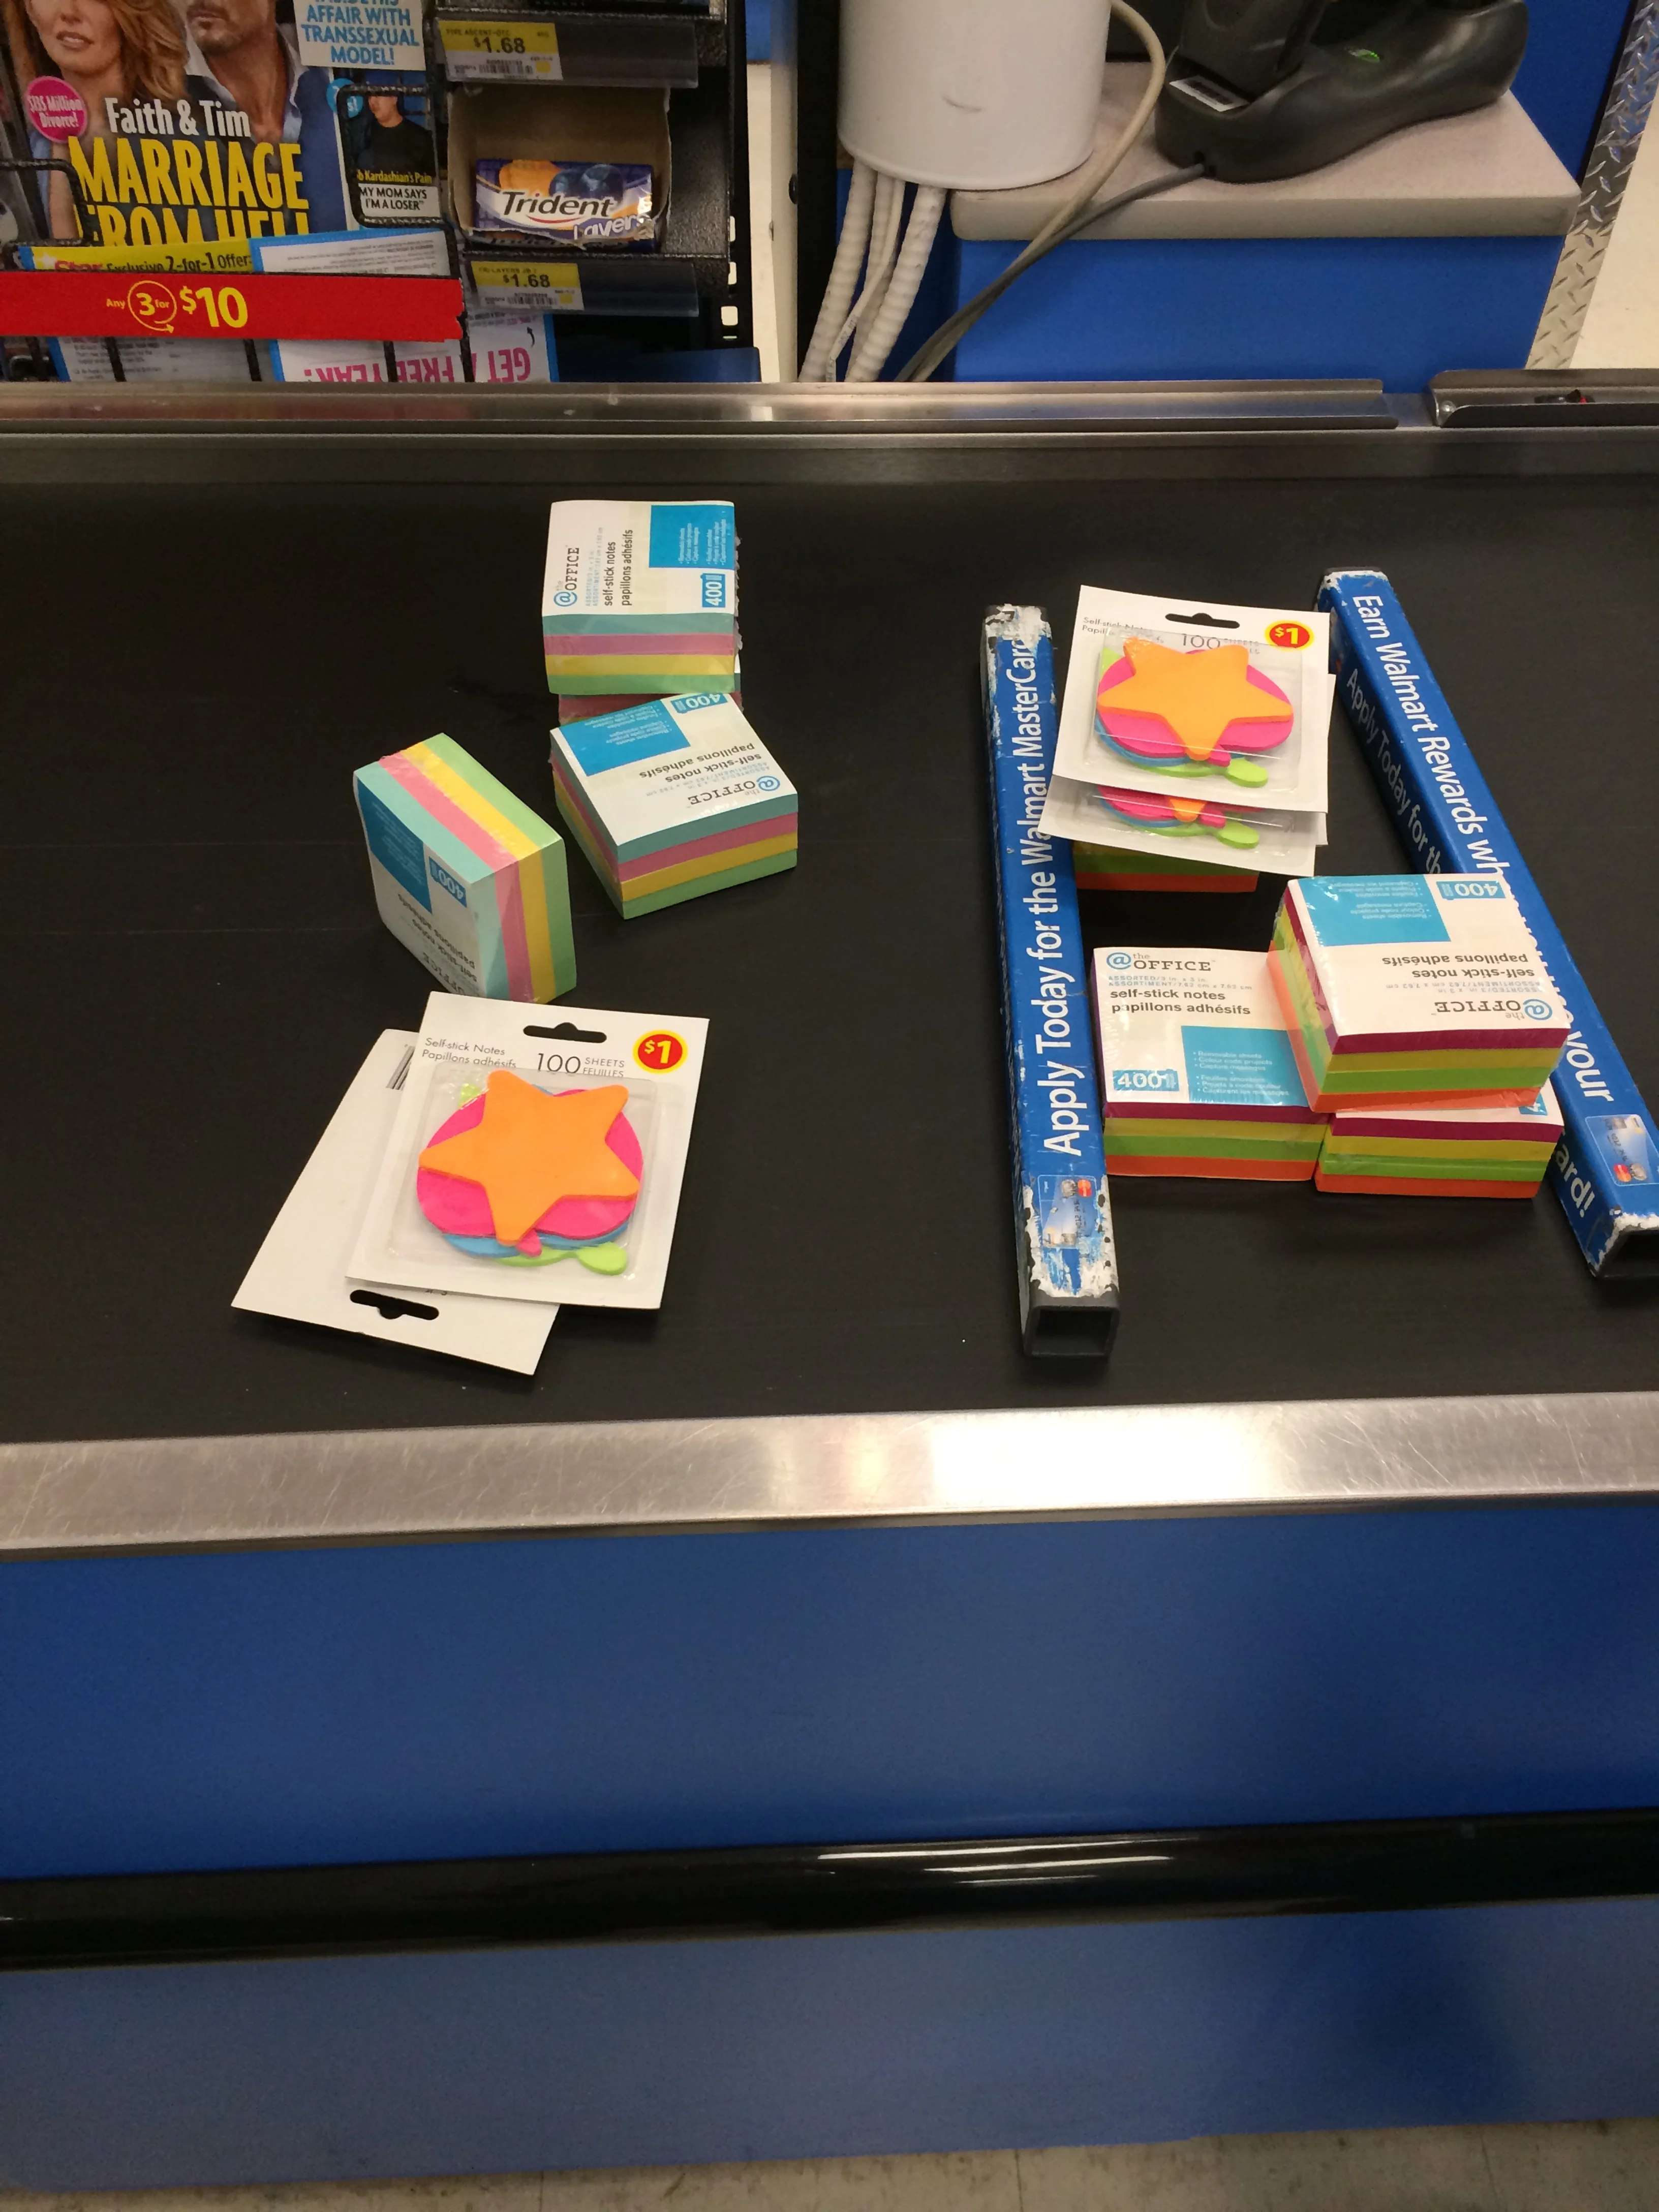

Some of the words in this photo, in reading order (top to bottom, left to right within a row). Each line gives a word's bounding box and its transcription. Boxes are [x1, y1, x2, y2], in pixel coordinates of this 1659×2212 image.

[307, 5, 363, 24] AFFAIR
[364, 7, 410, 26] WITH
[301, 24, 420, 46] TRANSSEXUAL
[474, 37, 525, 53] $1.68
[331, 46, 394, 65] MODEL!
[46, 96, 82, 111] Million
[39, 111, 79, 128] Divorce!
[105, 98, 174, 135] Faith
[178, 102, 196, 133] &
[200, 99, 251, 137] Tim
[68, 136, 309, 209] MARRIAGE
[364, 170, 414, 182] Kardashian's
[415, 172, 432, 184] Pain
[377, 187, 402, 197] MOM
[405, 188, 427, 199] SAYS
[382, 200, 388, 208] A
[502, 192, 613, 217] Trident
[503, 274, 550, 288] $1.68
[106, 298, 126, 310] Any
[136, 293, 155, 315] 3
[155, 299, 169, 309] for
[179, 286, 248, 328] $10
[488, 347, 531, 382] GET
[605, 541, 616, 564] notes
[621, 529, 633, 563] adhésifs
[565, 547, 579, 591] OFFICE
[603, 567, 615, 606] self-stick
[620, 566, 633, 606] papillons
[705, 581, 722, 606] 400
[1275, 626, 1299, 645] $1
[686, 693, 721, 709] 400
[1353, 595, 1390, 638] Earn
[1376, 642, 1438, 732] Walmart
[1418, 735, 1488, 835] Rewards
[697, 743, 755, 762] papillons
[1346, 668, 1377, 745] Apply
[1377, 730, 1411, 816] Today
[1408, 804, 1428, 852] for
[640, 755, 693, 779] adhésifs
[706, 753, 762, 774] self-stick
[665, 767, 701, 783] notes
[688, 780, 756, 805] OFFICE
[1017, 763, 1054, 865] Walmart
[438, 870, 464, 900] 400
[1023, 872, 1058, 914] the
[1455, 883, 1498, 896] 400
[434, 929, 475, 969] papillons
[1027, 920, 1062, 959] for
[1133, 960, 1211, 971] OFFICE
[1382, 956, 1451, 966] adhésifs
[1455, 954, 1528, 964] papillons
[1412, 968, 1458, 977] notes
[1461, 969, 1534, 977] self-stick
[1110, 989, 1179, 999] self-stick
[1184, 991, 1225, 1000] notes
[1031, 966, 1076, 1054] Today
[1112, 1002, 1182, 1013] papillons
[1187, 1004, 1250, 1015] adhésifs
[1434, 1000, 1521, 1012] OFFICE
[425, 1037, 470, 1052] Self-stick
[473, 1042, 505, 1056] Notes
[644, 1040, 672, 1064] $1
[422, 1049, 470, 1064] Papillons
[473, 1055, 517, 1069] adhésifs
[537, 1052, 581, 1074] 100
[585, 1057, 625, 1068] SHEETS
[583, 1066, 624, 1078] FEUILLES
[1117, 1072, 1160, 1088] 400
[1037, 1061, 1090, 1156] Apply
